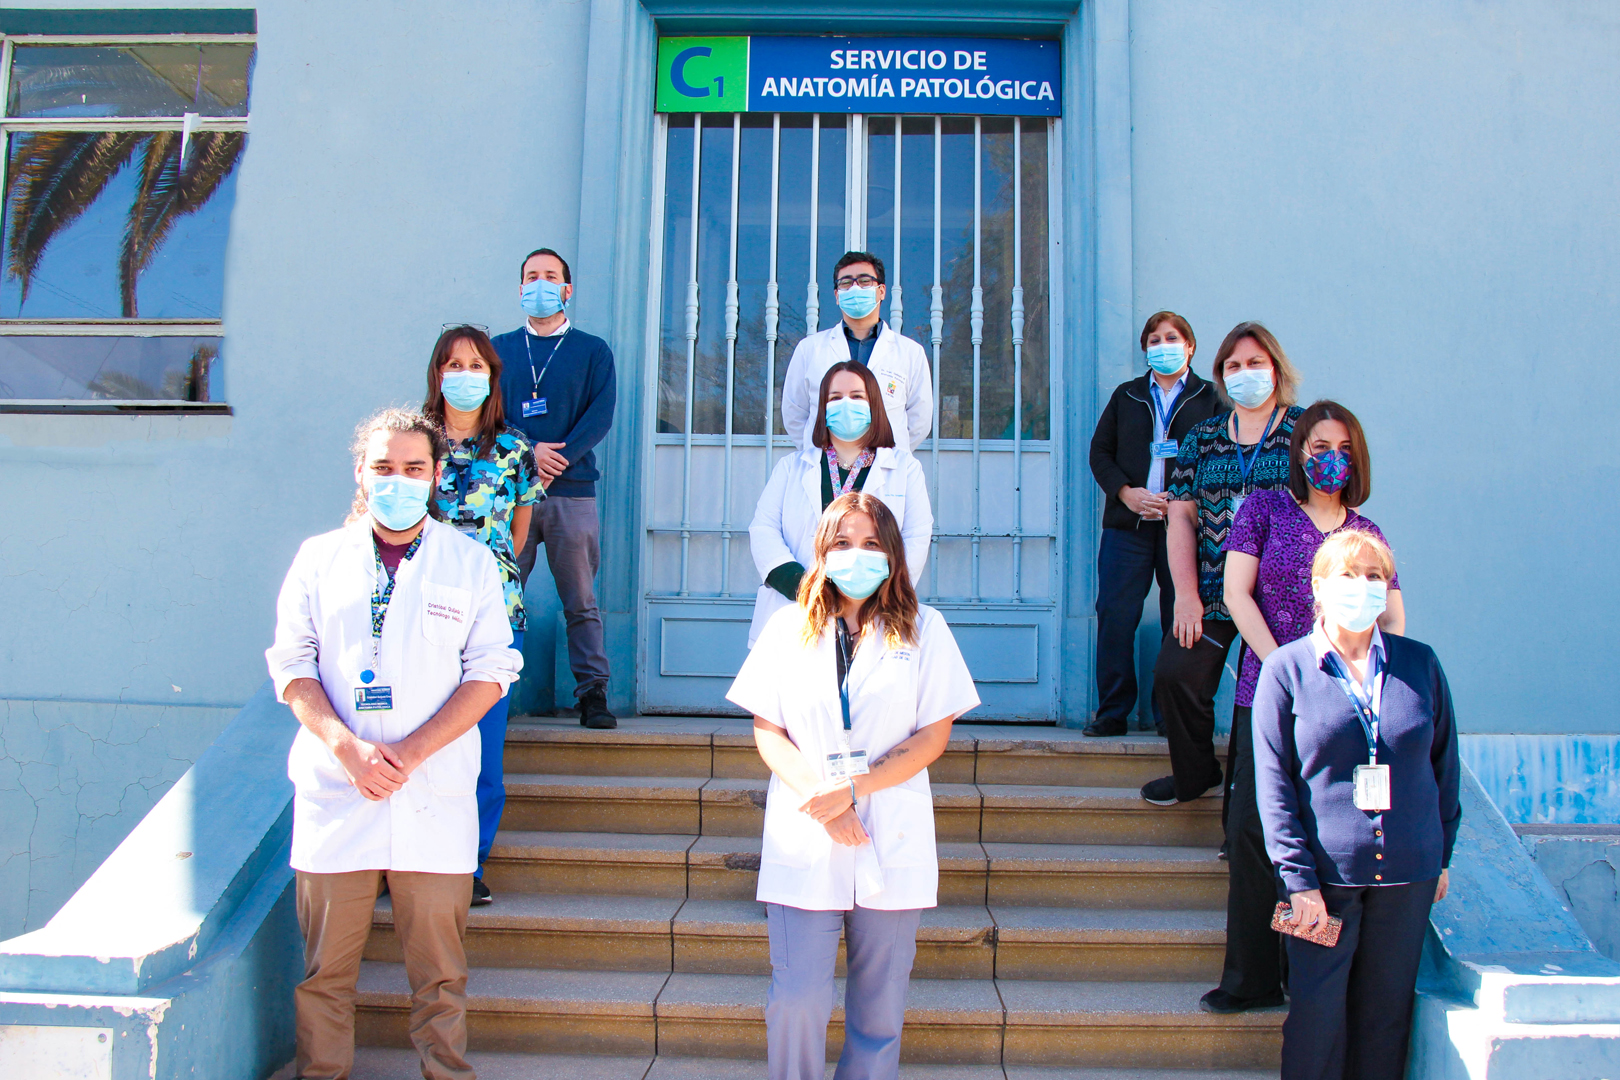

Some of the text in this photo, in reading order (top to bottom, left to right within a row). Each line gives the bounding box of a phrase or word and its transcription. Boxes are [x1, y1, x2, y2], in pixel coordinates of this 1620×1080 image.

[830, 49, 987, 71] SERVICIO DE
[761, 73, 1055, 101] ANATOMÍA PATOLÓGICA
